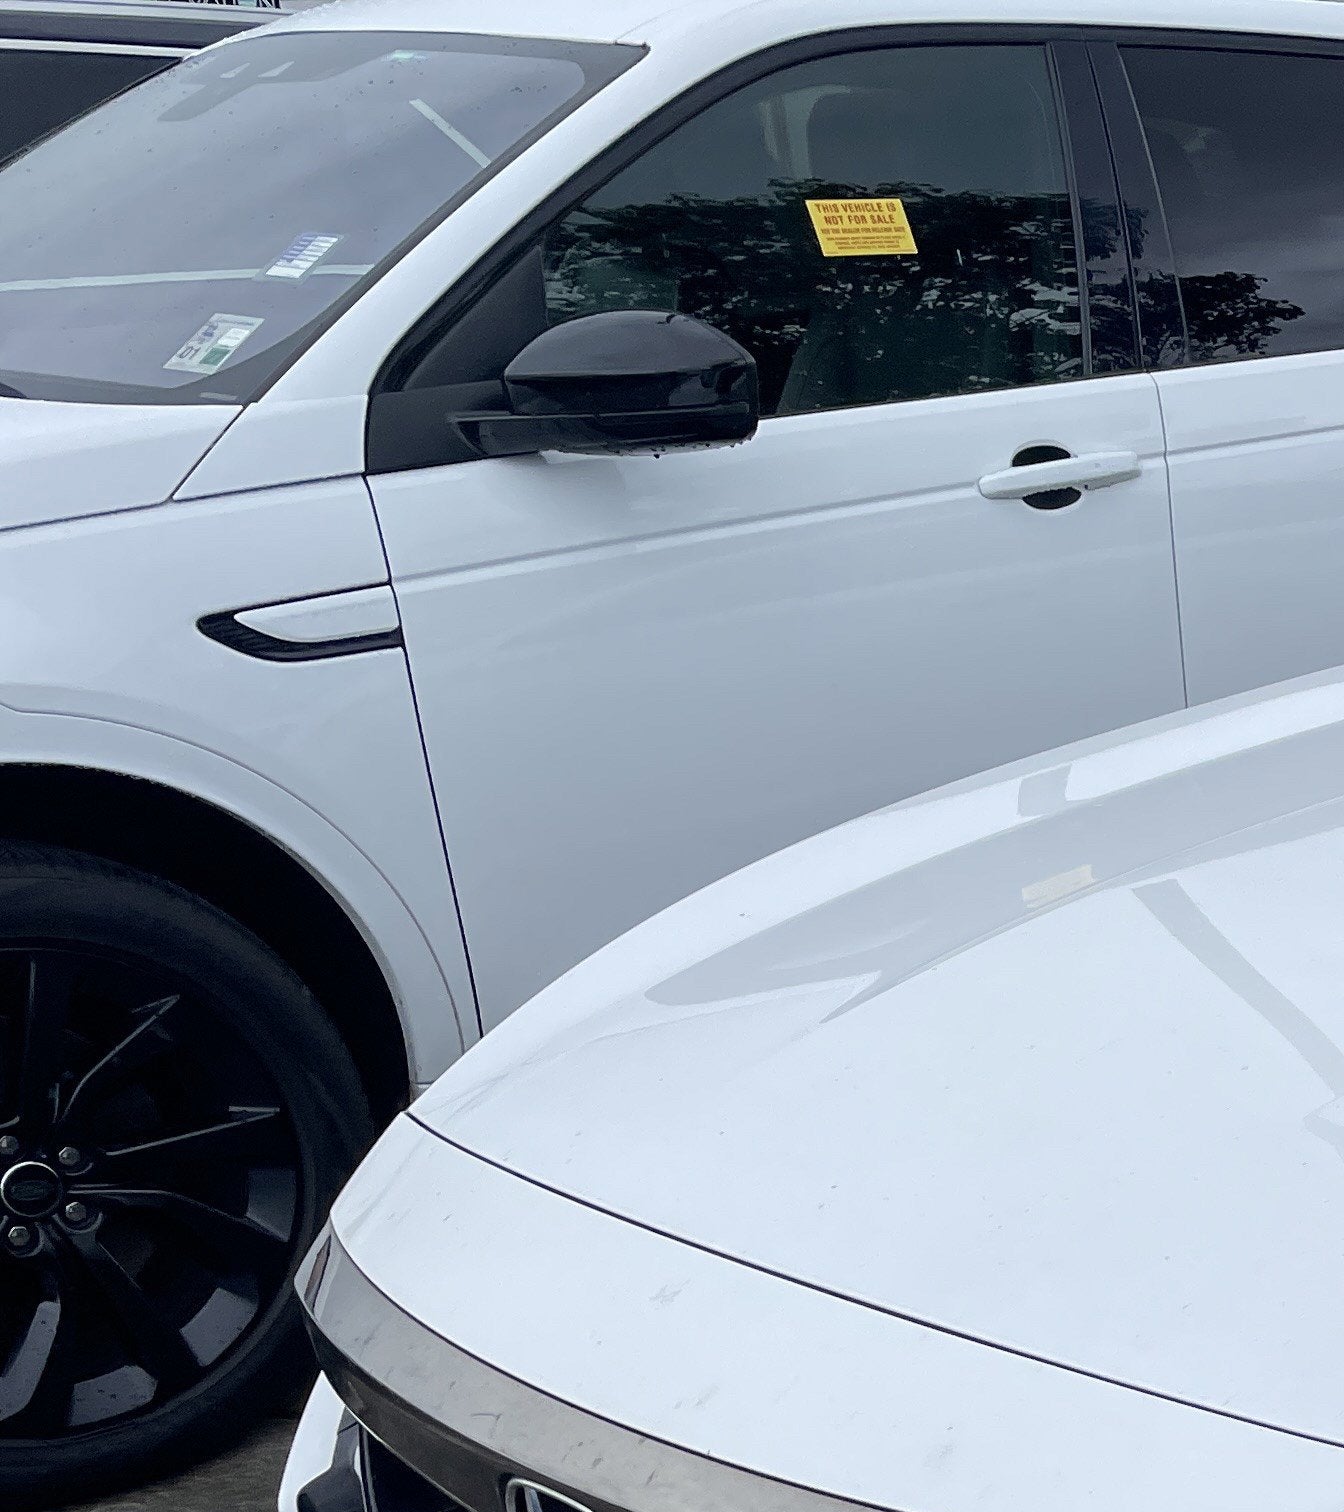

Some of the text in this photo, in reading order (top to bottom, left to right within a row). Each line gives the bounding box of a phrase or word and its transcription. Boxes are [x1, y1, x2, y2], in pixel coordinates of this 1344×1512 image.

[814, 202, 896, 213] THIS VEHICLE IS
[824, 214, 895, 225] NOT FOR SALE
